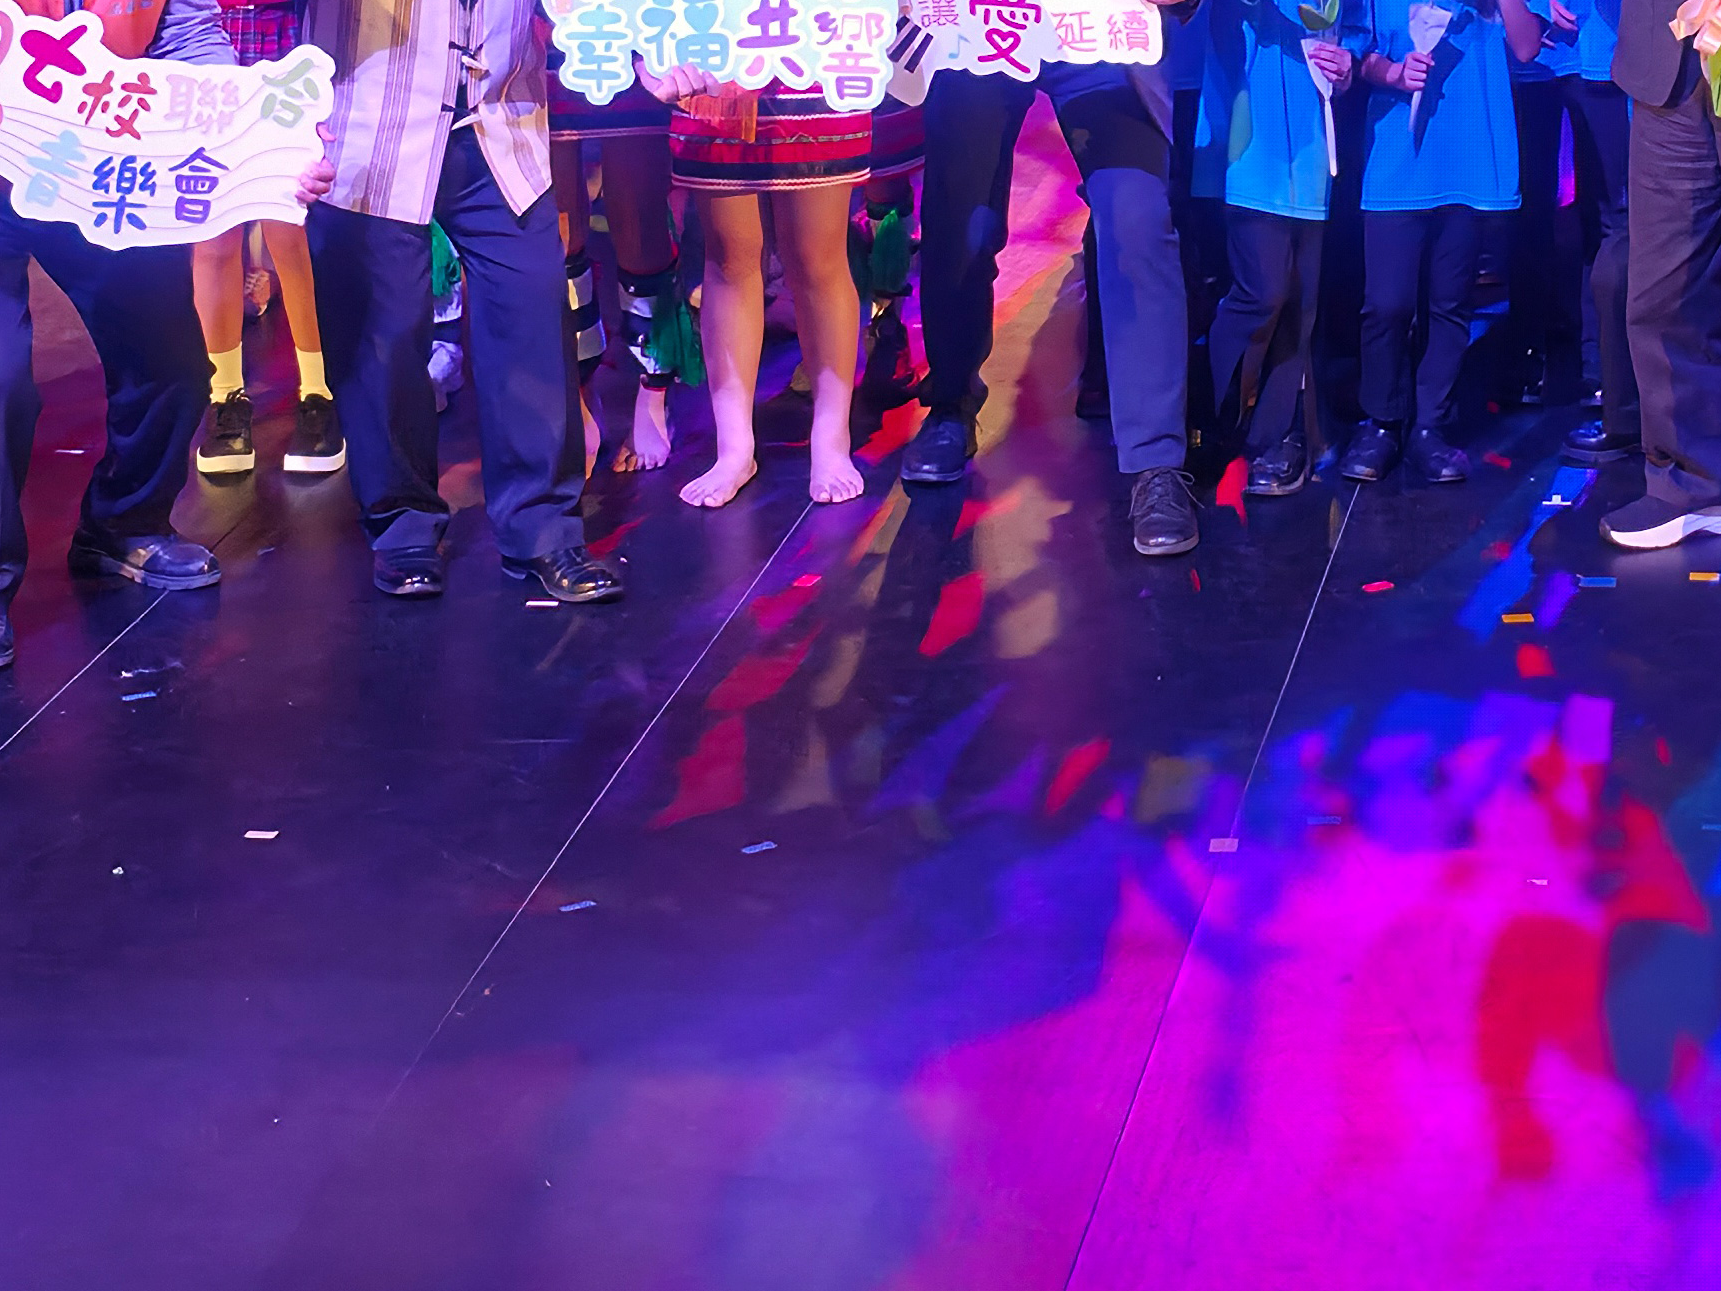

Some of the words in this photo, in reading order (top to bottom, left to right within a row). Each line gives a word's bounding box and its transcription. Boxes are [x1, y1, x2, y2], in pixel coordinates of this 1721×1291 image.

[19, 24, 320, 140] 七校聯合
[26, 129, 230, 234] 音樂會
